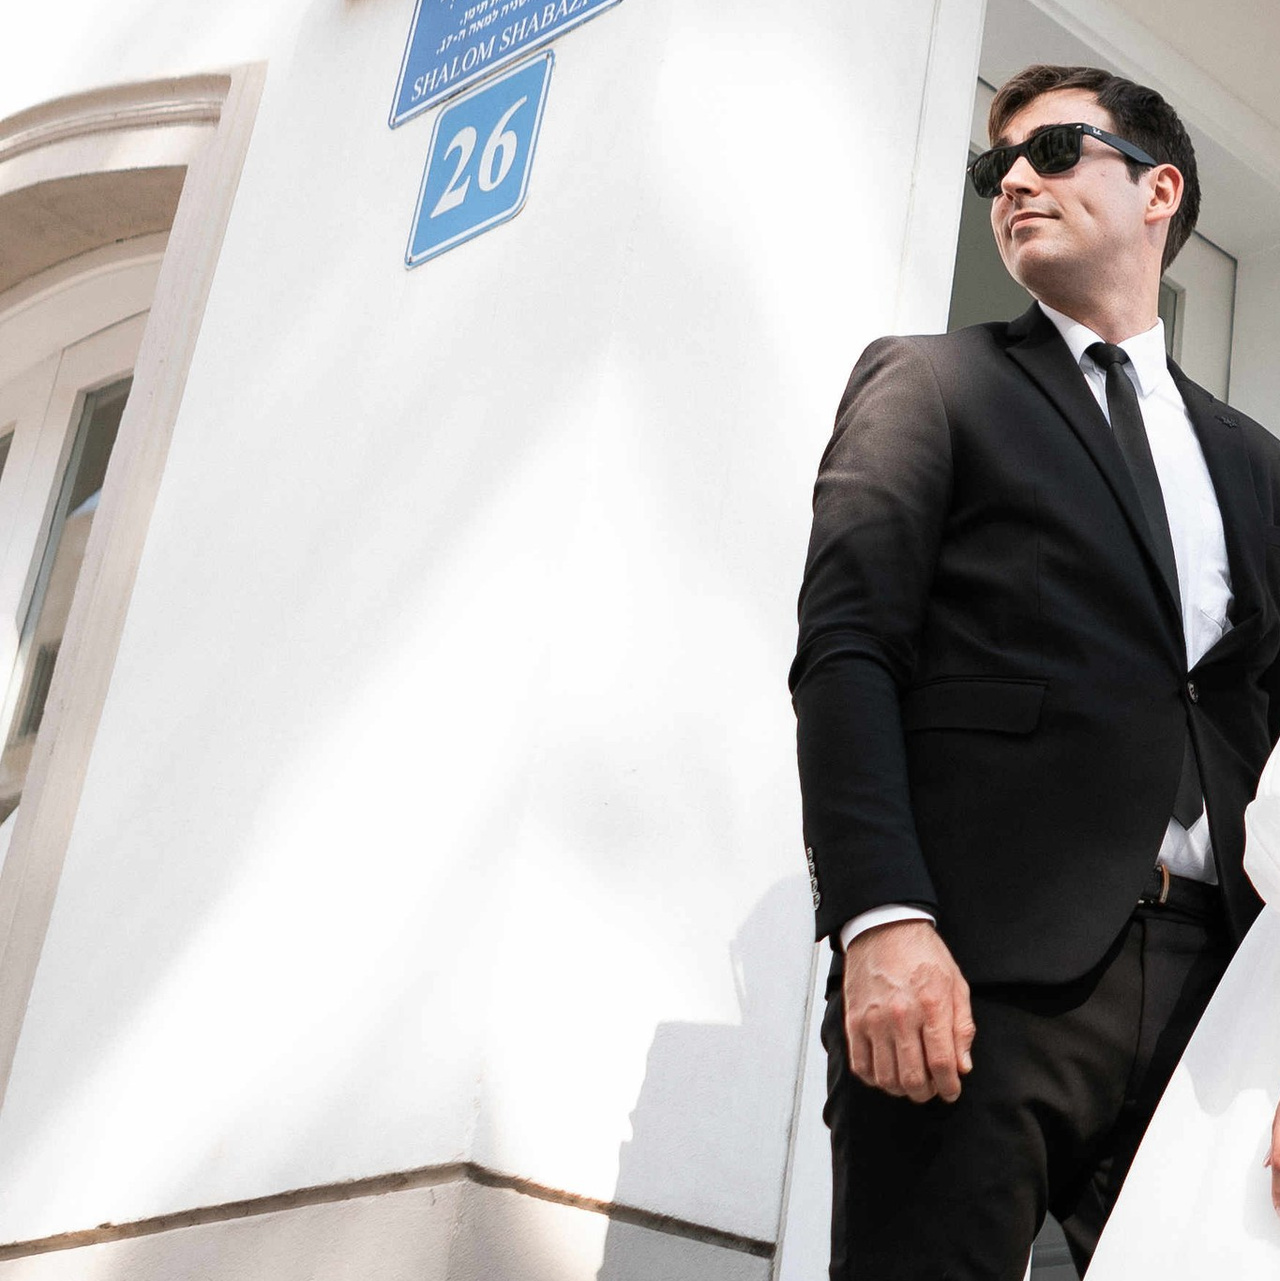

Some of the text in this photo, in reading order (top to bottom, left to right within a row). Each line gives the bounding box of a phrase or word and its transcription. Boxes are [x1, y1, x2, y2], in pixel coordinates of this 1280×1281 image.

[468, 9, 499, 36] למאה
[411, 36, 496, 101] SHALOM
[430, 95, 527, 219] 26
